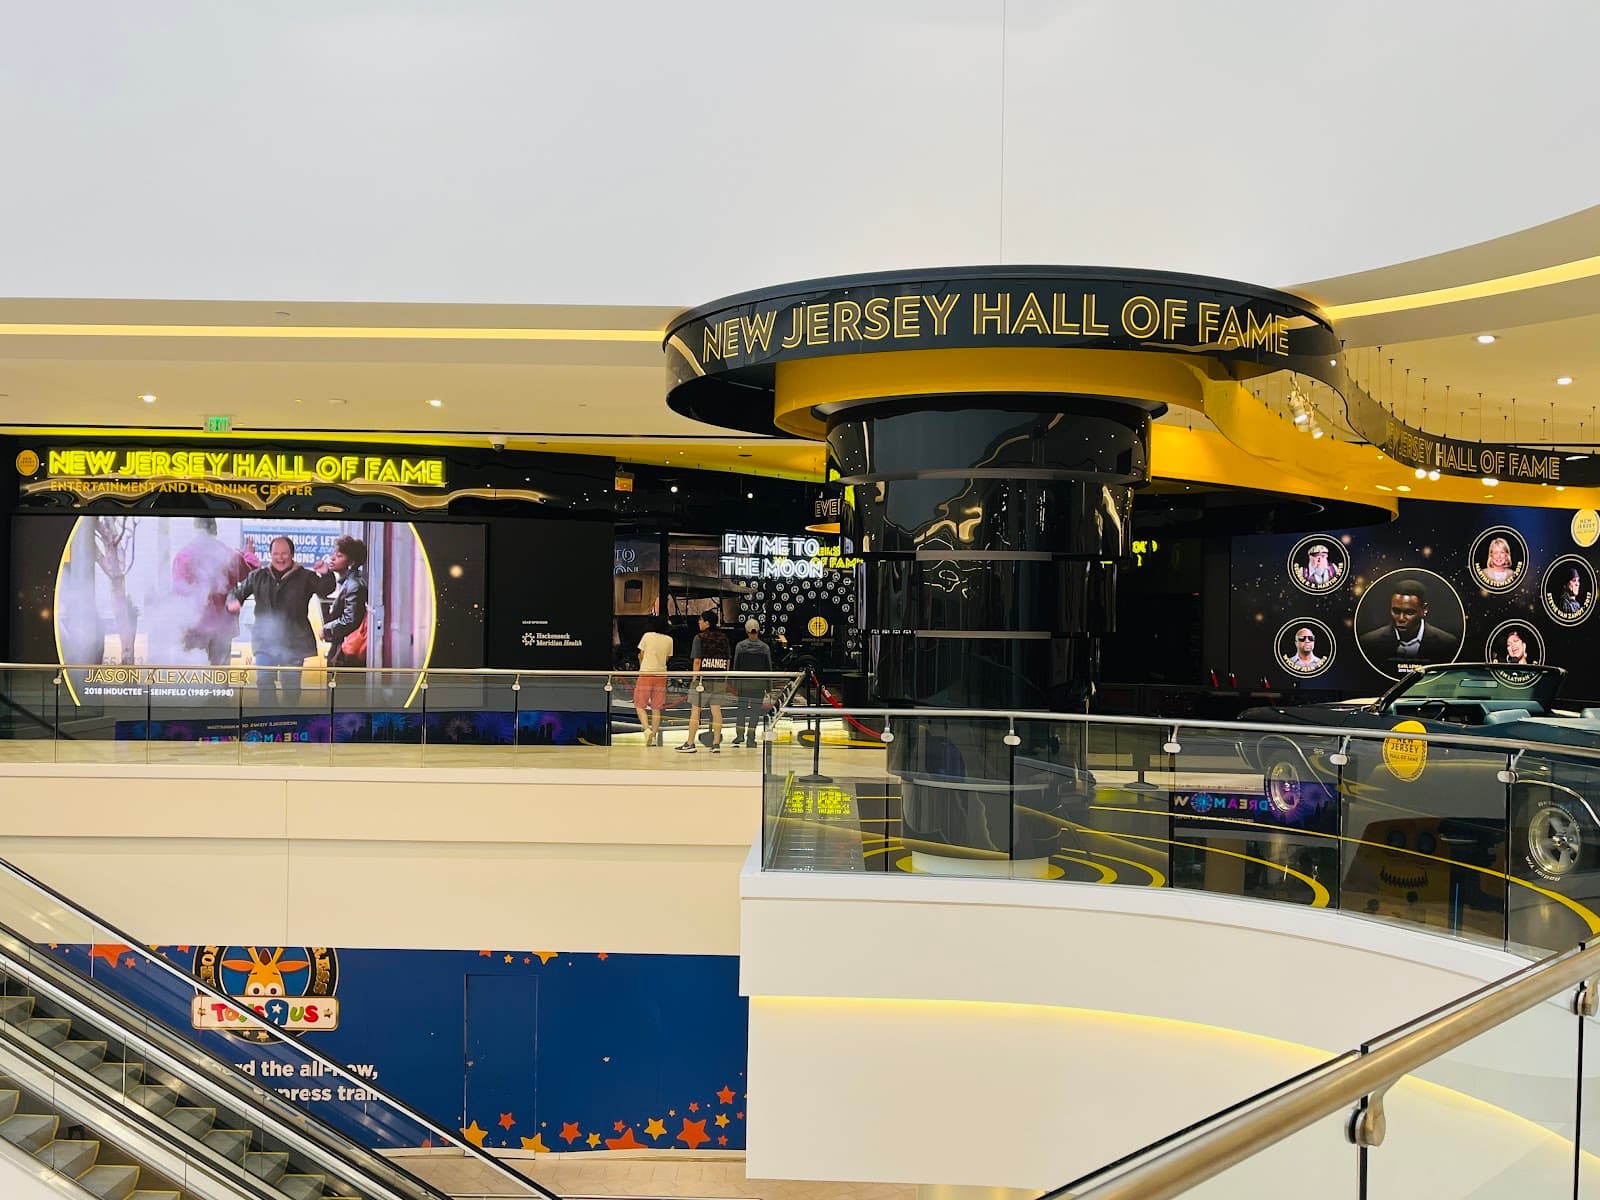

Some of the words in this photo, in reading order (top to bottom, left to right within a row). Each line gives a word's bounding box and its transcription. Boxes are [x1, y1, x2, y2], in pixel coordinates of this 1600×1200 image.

[703, 310, 777, 364] NEW
[781, 293, 961, 349] JERSEY
[973, 292, 1109, 336] HALL
[1121, 295, 1189, 340] OF
[1198, 302, 1289, 357] FAME
[48, 450, 117, 476] NEW
[120, 451, 229, 478] JERSEY
[232, 453, 313, 481] HALL
[315, 455, 360, 482] OF
[364, 457, 444, 485] FAME
[1435, 442, 1478, 473] HALL
[1480, 449, 1505, 474] OF
[1508, 452, 1561, 480] FAME
[50, 481, 156, 494] ENTERTAINMENT
[159, 482, 187, 494] AND
[190, 482, 258, 495] LEARNING
[260, 484, 313, 496] CENTER
[724, 533, 760, 554] FLY
[762, 535, 789, 556] ME
[792, 537, 820, 557] TO
[720, 556, 760, 577] THE
[763, 557, 824, 579] MOON
[701, 658, 728, 669] CHANGE
[84, 668, 141, 684] JASON
[145, 669, 250, 685] ALEXANDER
[84, 687, 103, 696] 2018
[103, 688, 143, 696] INDUCTEE
[150, 688, 187, 697] SEINFELD
[1391, 743, 1419, 753] JERSEY
[261, 1060, 295, 1077] the
